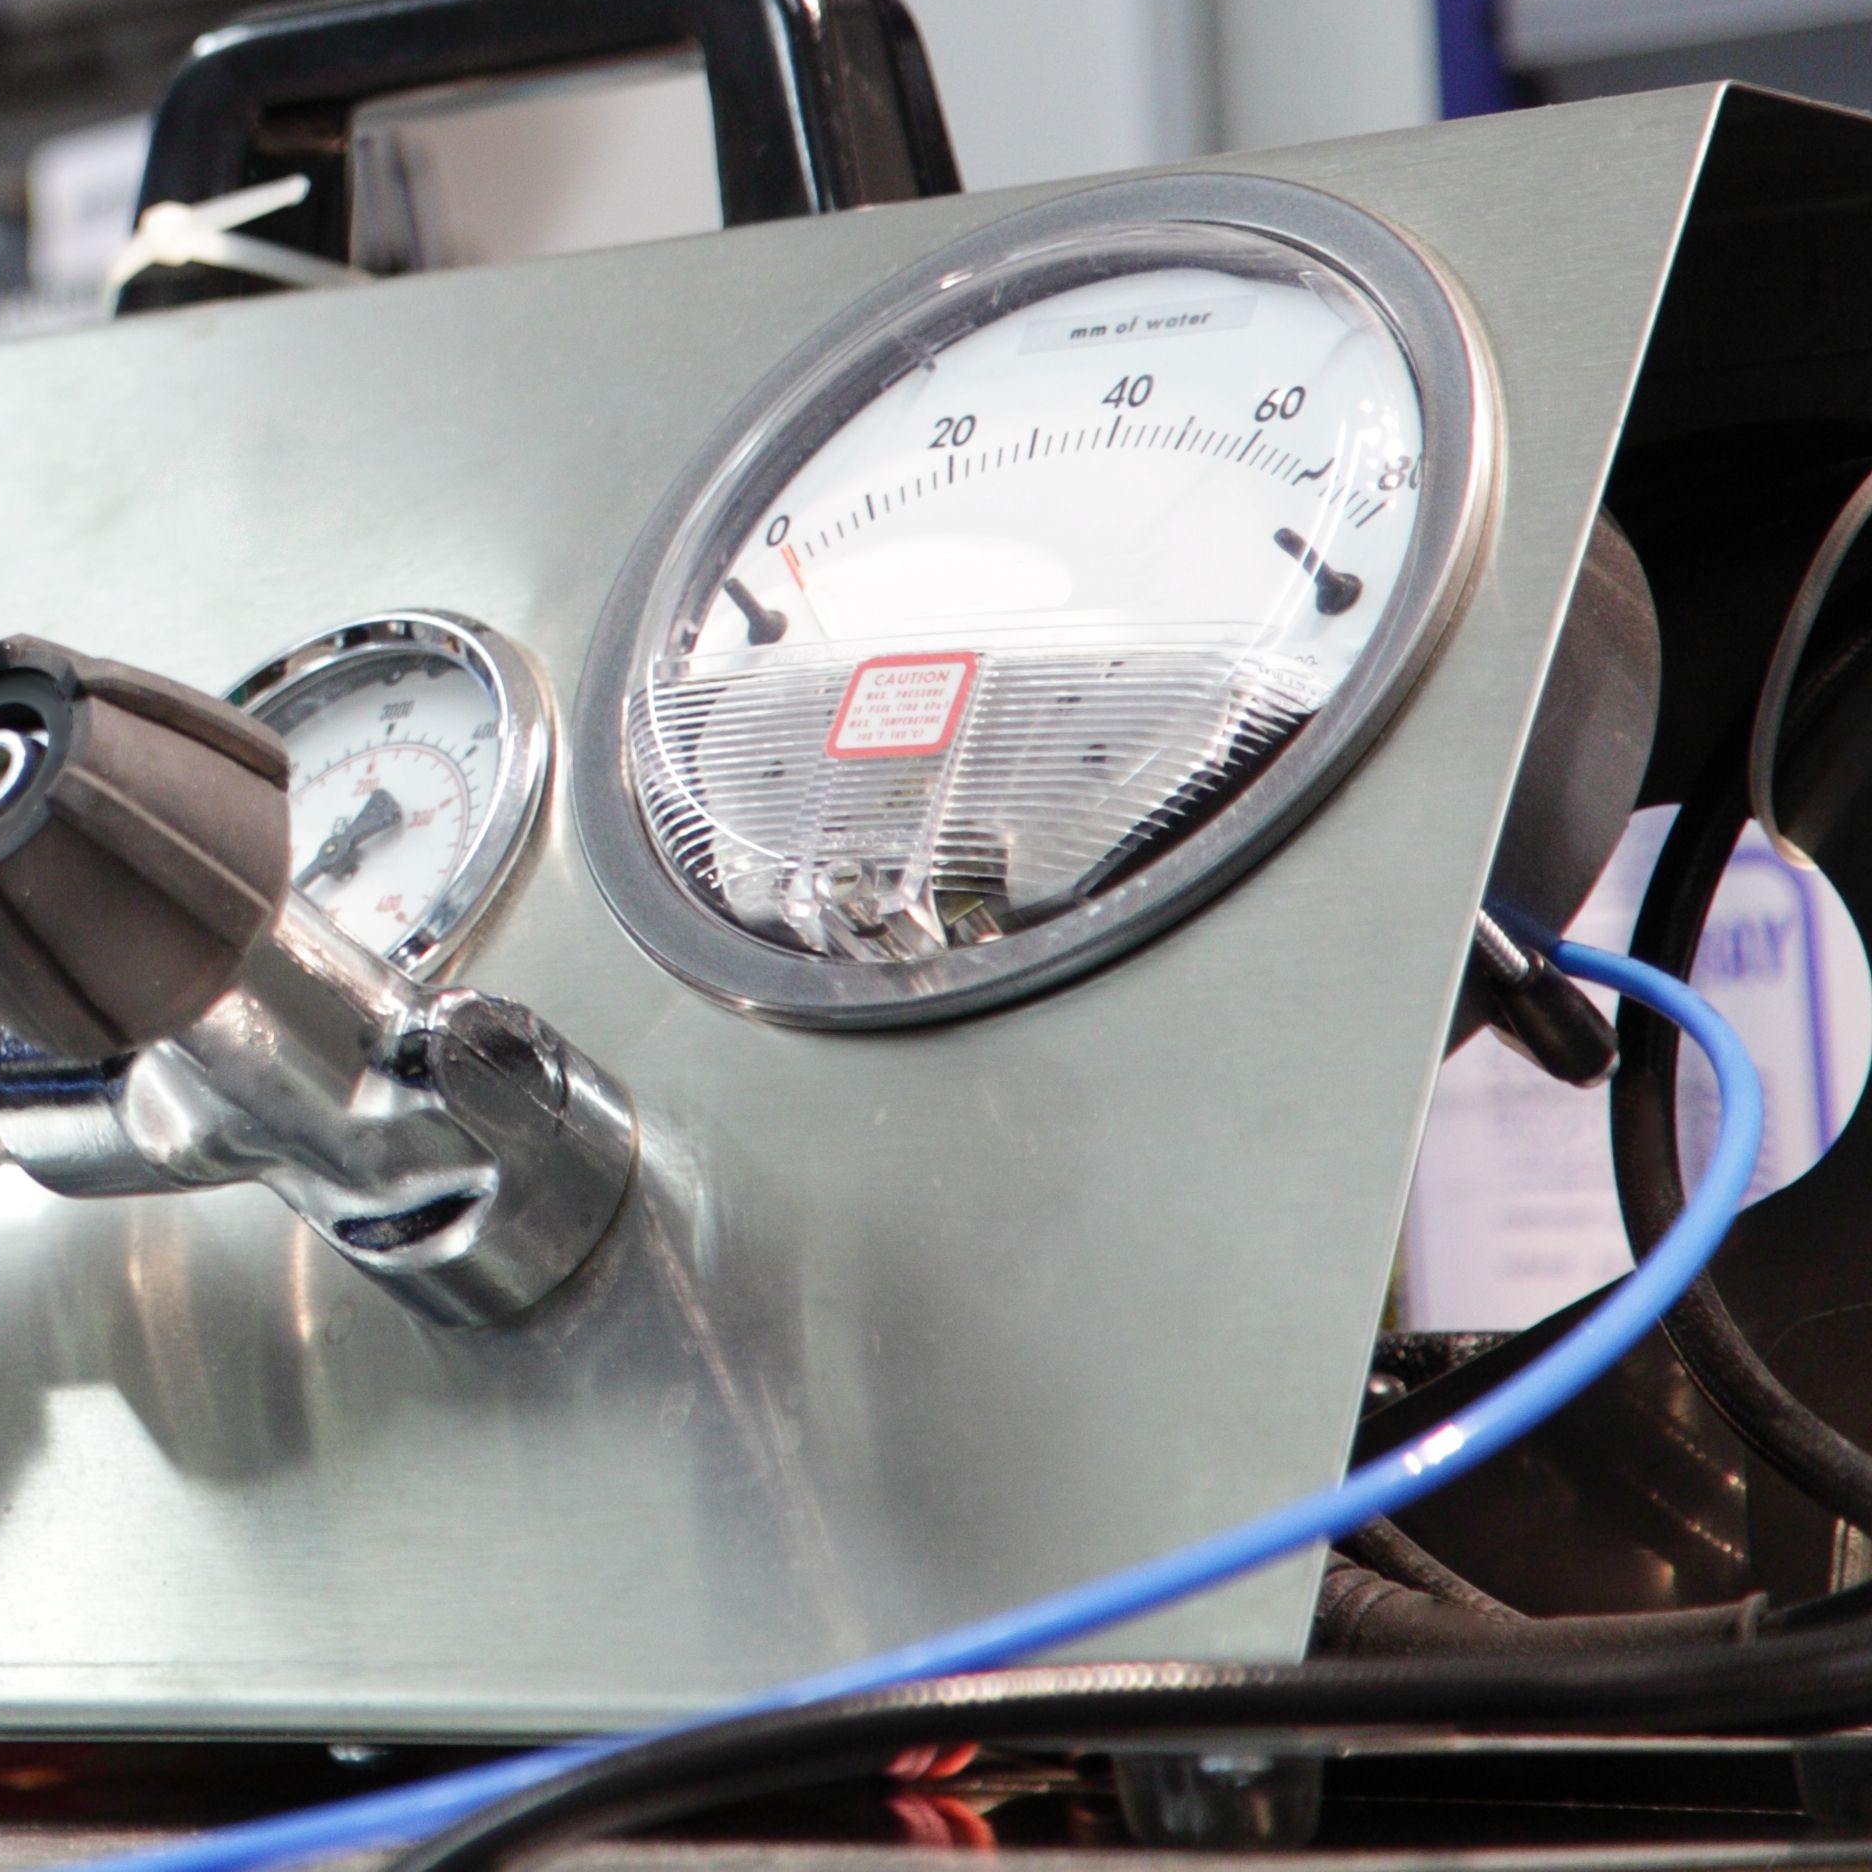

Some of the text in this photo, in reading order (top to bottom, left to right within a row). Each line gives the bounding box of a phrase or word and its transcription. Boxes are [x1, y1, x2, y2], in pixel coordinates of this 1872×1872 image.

[1069, 311, 1213, 340] mm of water
[1101, 373, 1154, 409] 40
[1253, 385, 1306, 423] 60
[927, 414, 977, 450] 20
[765, 514, 791, 547] 0
[873, 669, 951, 687] CAUTION
[378, 700, 416, 722] 3000
